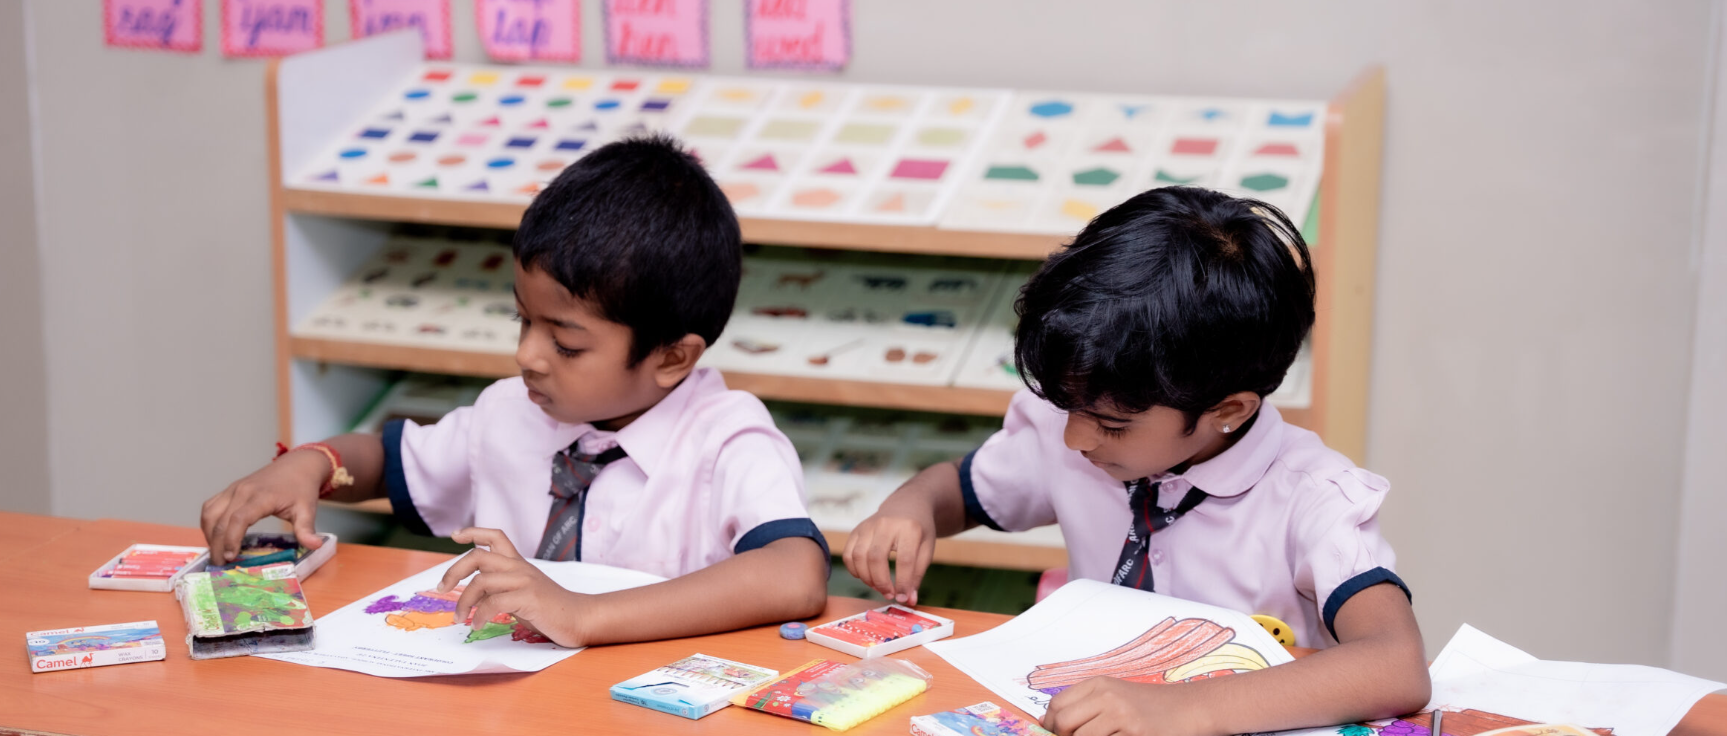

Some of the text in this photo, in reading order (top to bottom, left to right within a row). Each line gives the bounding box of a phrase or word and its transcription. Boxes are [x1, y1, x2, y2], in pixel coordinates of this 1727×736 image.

[1118, 558, 1134, 580] ARC
[36, 656, 78, 670] Camel
[911, 723, 935, 736] Cam
